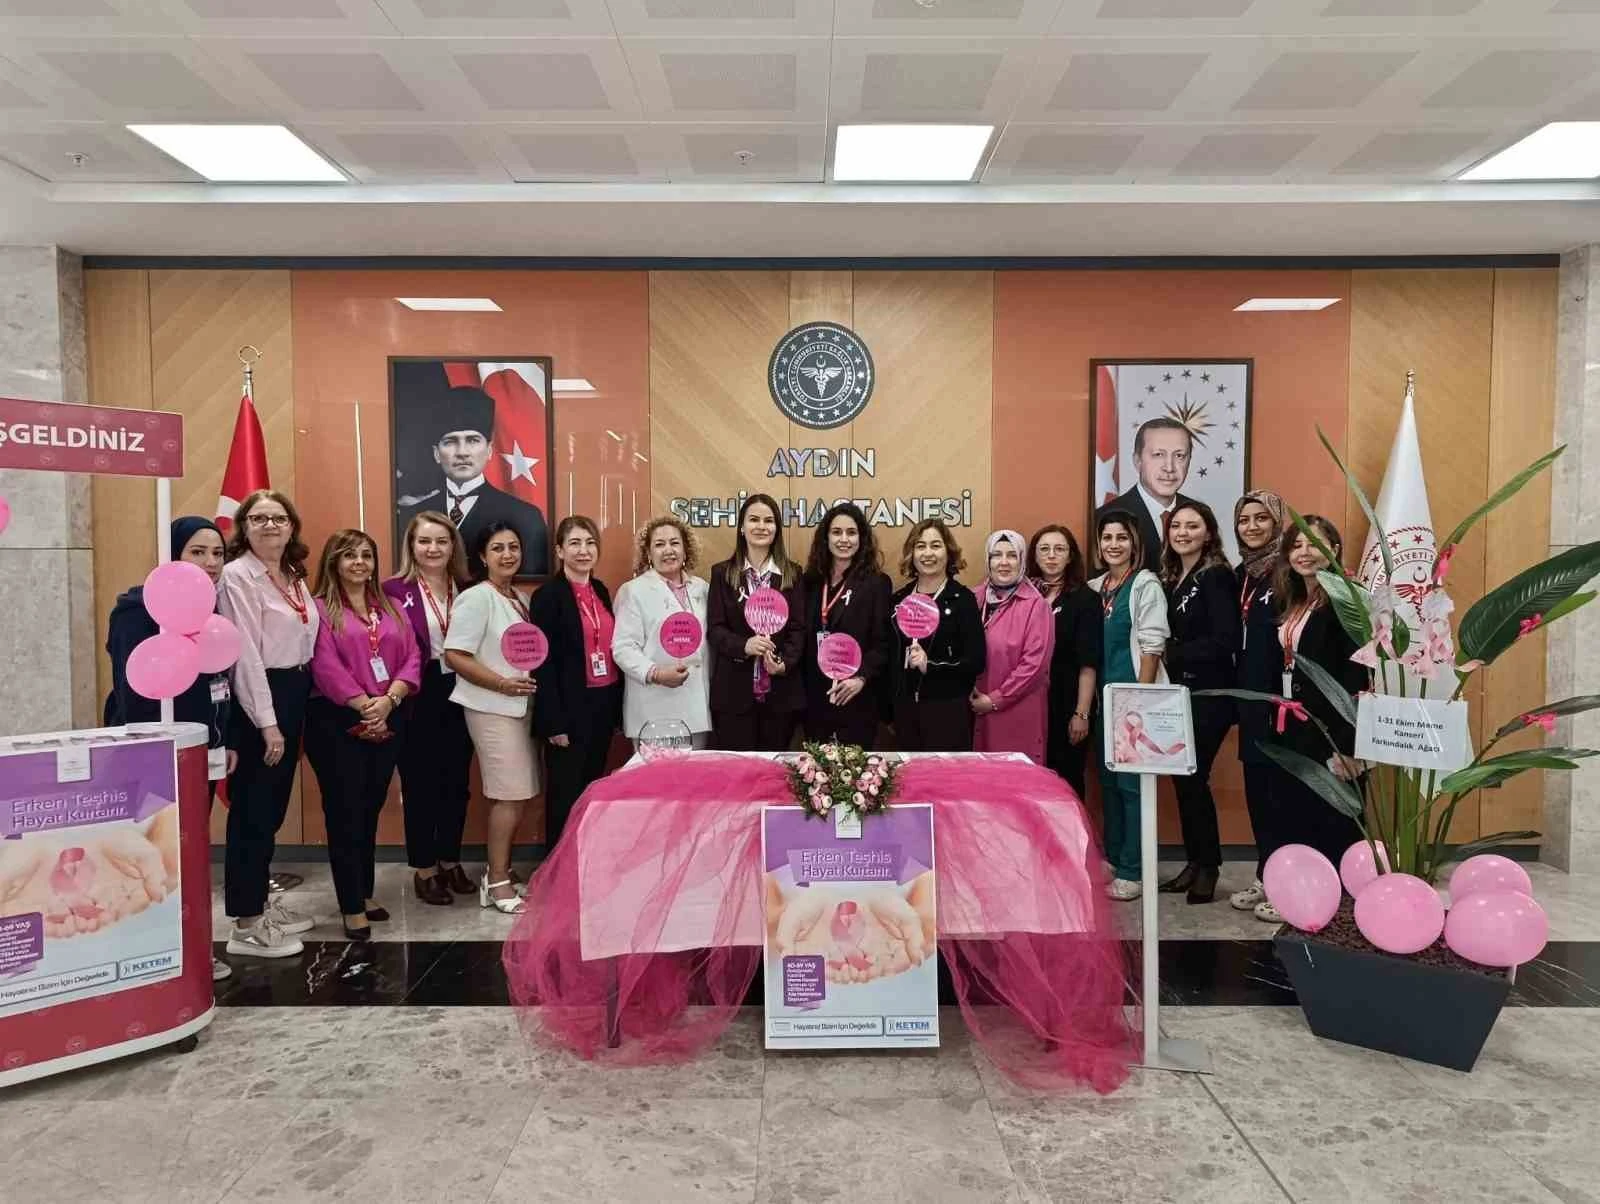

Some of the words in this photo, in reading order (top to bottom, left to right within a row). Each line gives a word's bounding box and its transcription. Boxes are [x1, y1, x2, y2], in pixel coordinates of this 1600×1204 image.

[767, 448, 875, 478] AYDIN
[781, 488, 972, 528] HATANESİ
[1396, 719, 1414, 728] Ekim
[1394, 729, 1424, 739] Kanseri
[12, 799, 67, 815] Erken
[12, 813, 63, 832] Hayat
[802, 848, 843, 865] Erken
[802, 865, 842, 880] Hayat
[133, 956, 171, 971] KETEM
[896, 1021, 929, 1030] KETEM
